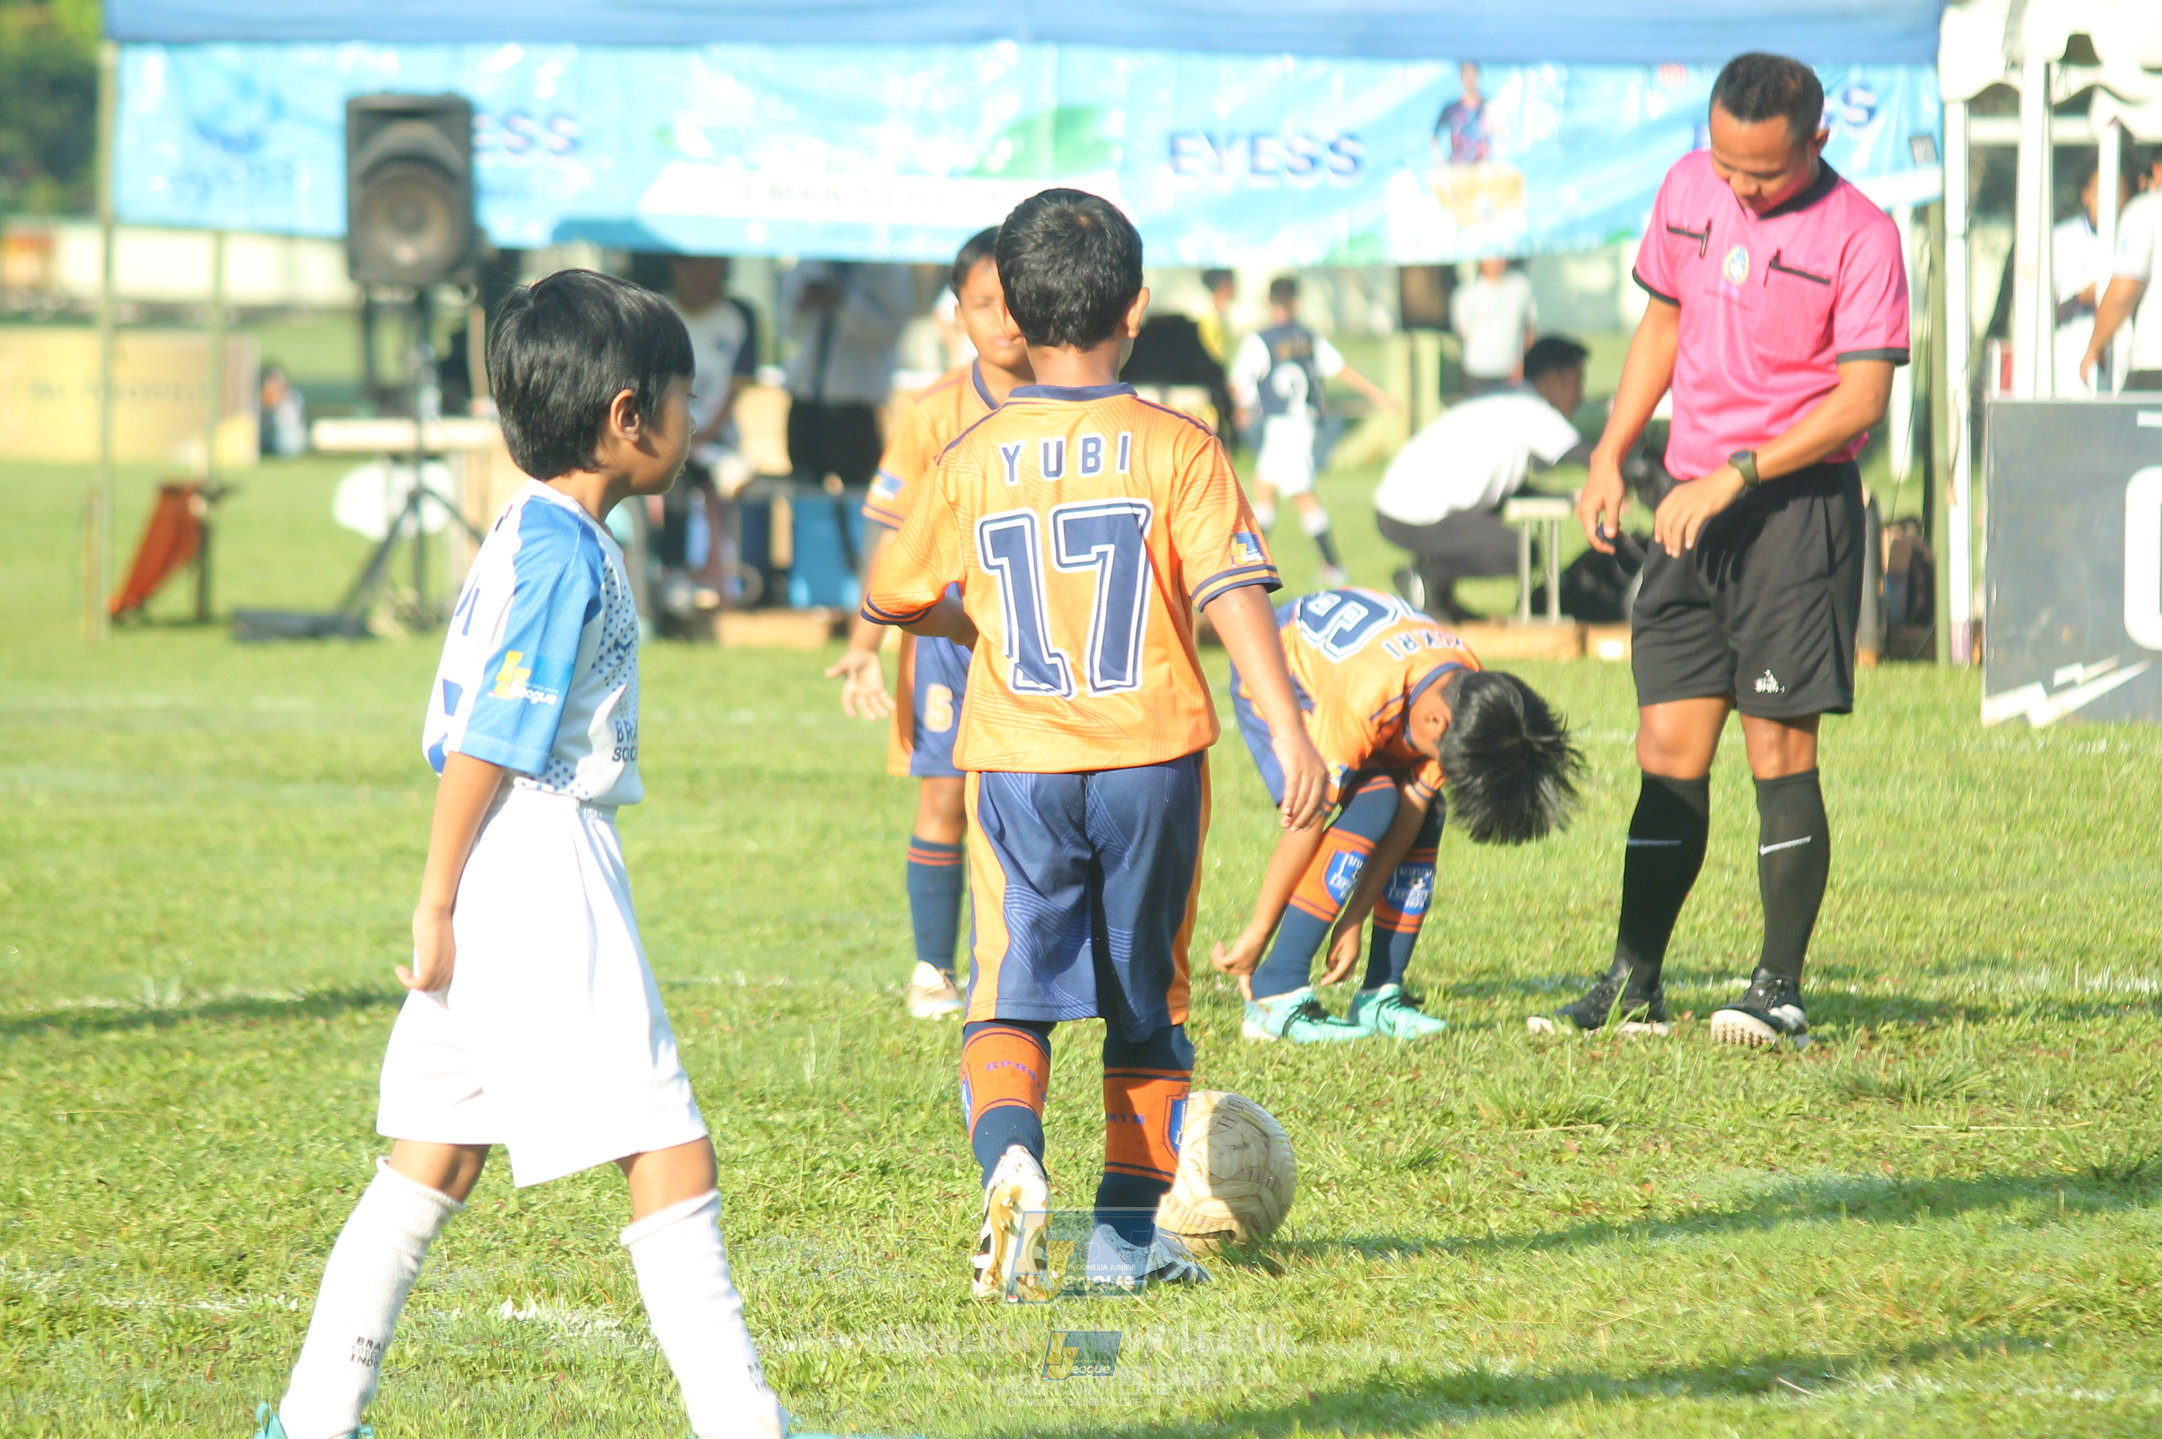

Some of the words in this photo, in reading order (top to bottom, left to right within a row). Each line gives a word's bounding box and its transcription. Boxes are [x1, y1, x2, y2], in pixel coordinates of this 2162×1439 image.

[472, 110, 581, 158] ESS
[1168, 130, 1367, 180] EYESS
[999, 431, 1133, 487] YUBI
[976, 498, 1154, 700] 17
